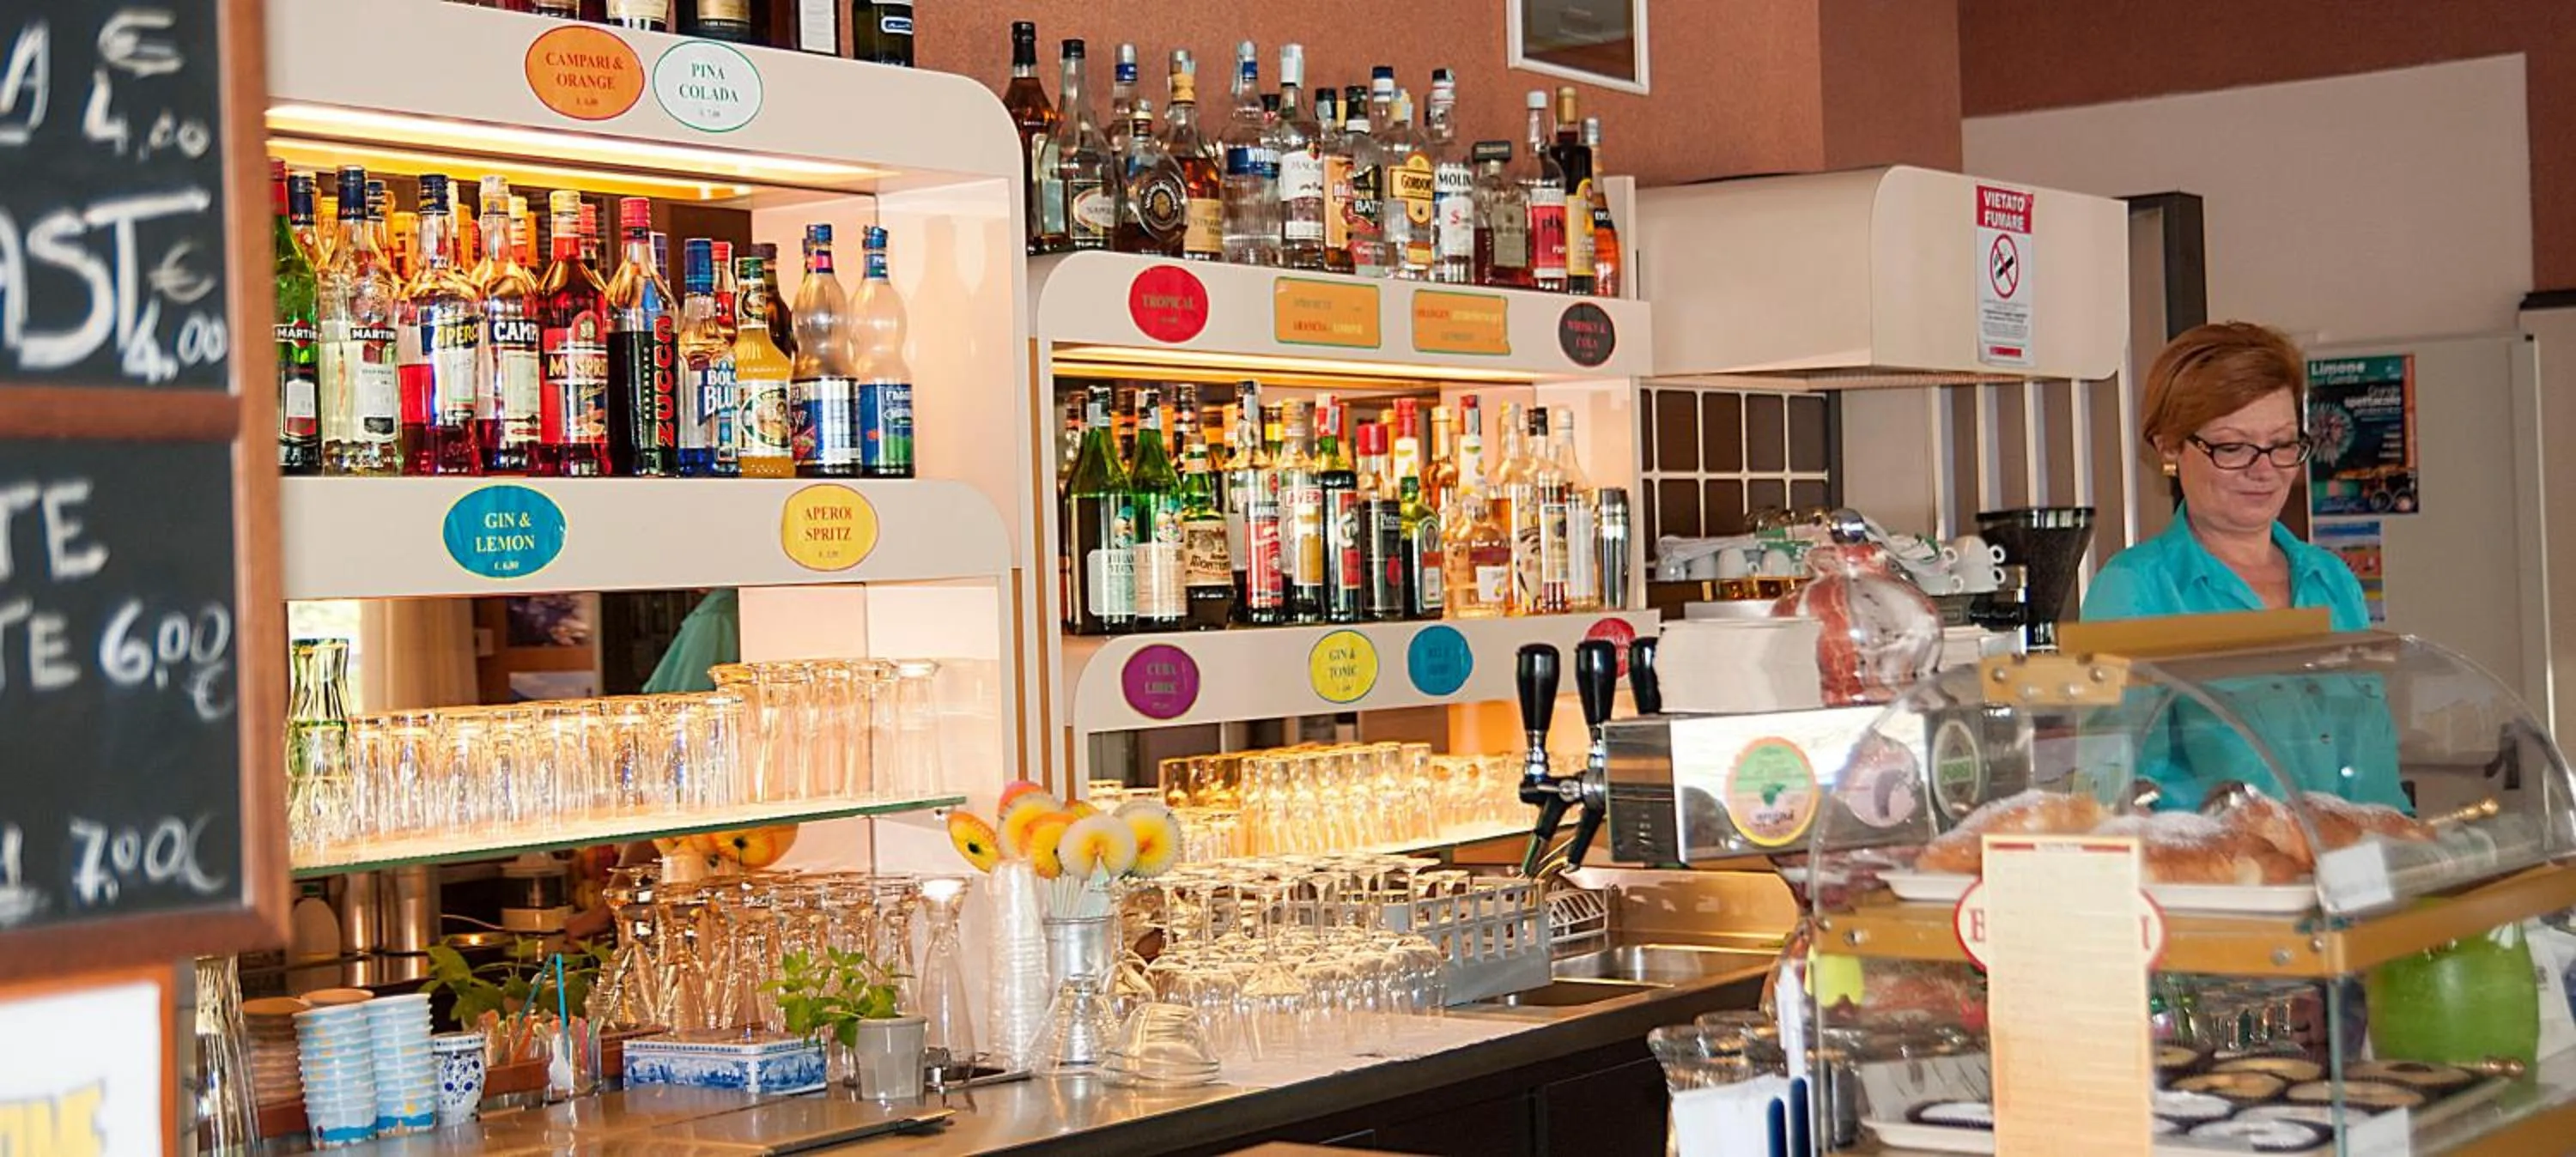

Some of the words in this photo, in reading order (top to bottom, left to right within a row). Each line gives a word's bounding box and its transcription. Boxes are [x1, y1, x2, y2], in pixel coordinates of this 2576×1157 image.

[545, 51, 611, 70] CAMPARI
[612, 56, 623, 70] &
[691, 62, 726, 80] PINA
[556, 72, 616, 90] ORANGE
[679, 83, 739, 102] COLADA
[1983, 189, 2025, 212] VIETATO
[1984, 209, 2025, 232] FUMARE
[2311, 361, 2366, 377] Limone
[483, 512, 515, 529] GIN
[519, 511, 532, 528] &
[804, 526, 853, 542] SPRITZ
[475, 534, 536, 554] LEMON
